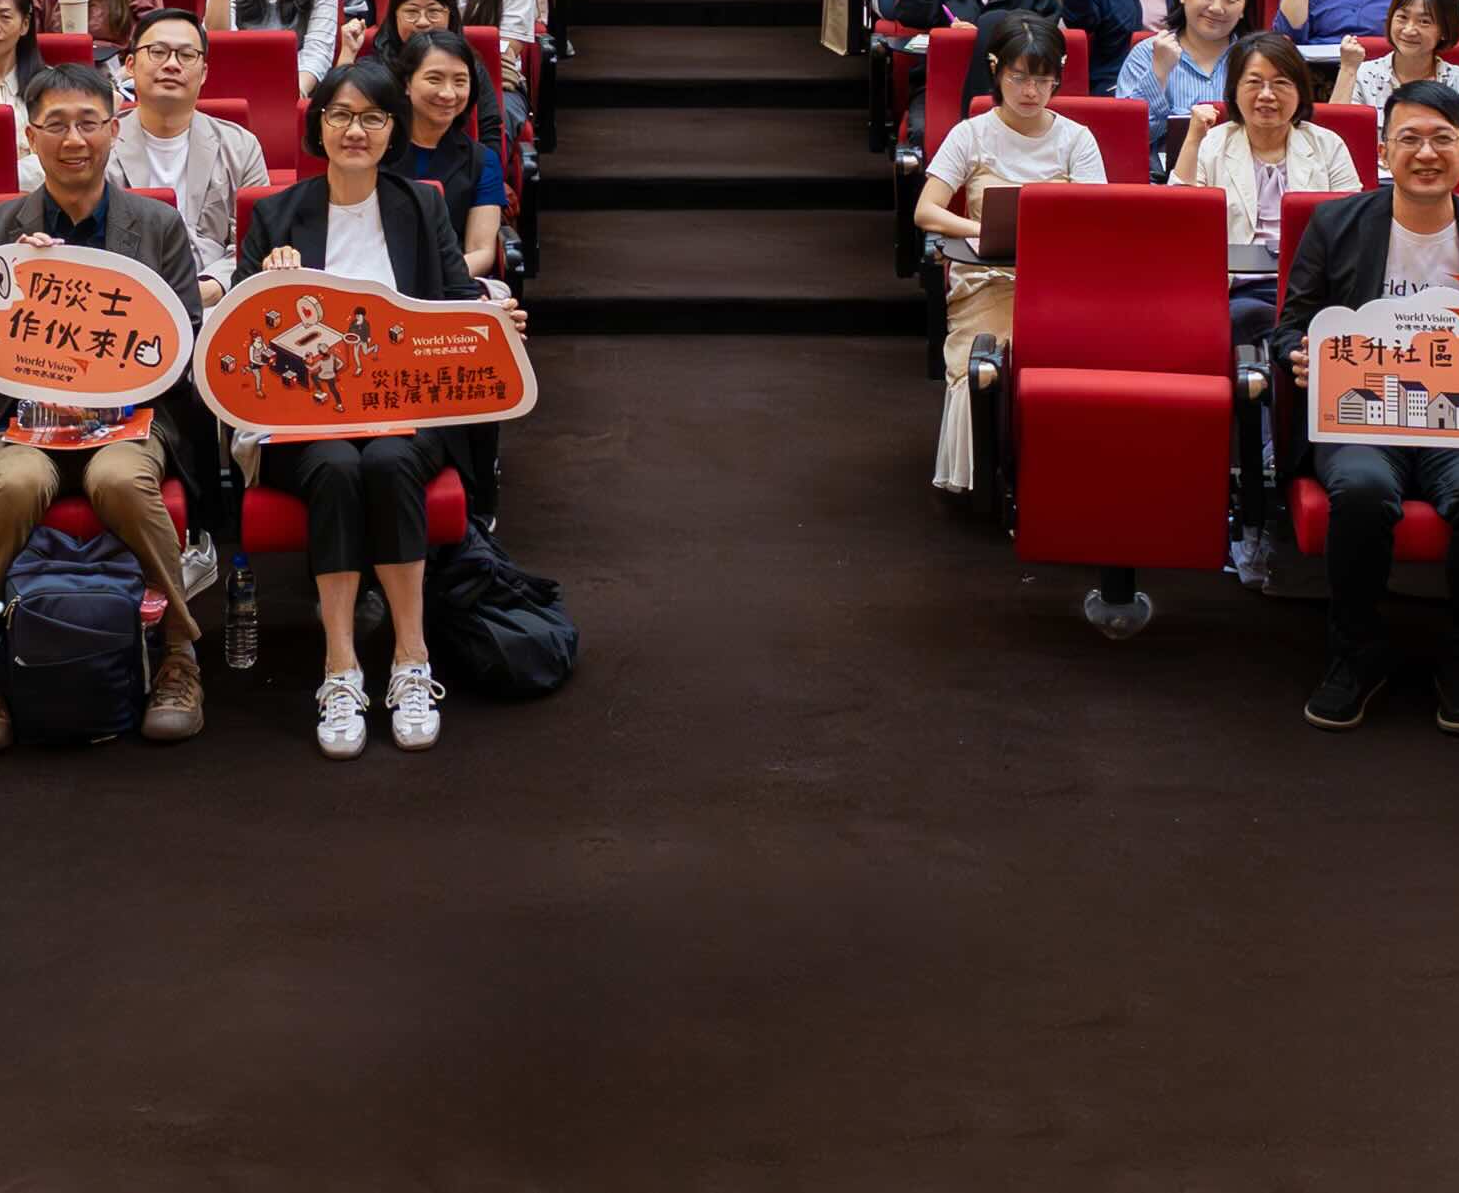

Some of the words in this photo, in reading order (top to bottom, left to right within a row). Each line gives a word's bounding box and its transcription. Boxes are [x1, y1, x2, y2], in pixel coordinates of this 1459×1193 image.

[29, 272, 132, 317] 防災士
[1394, 312, 1424, 322] World
[1426, 313, 1456, 323] Vision
[412, 335, 444, 347] World
[446, 334, 478, 344] Vision
[16, 354, 46, 368] World
[48, 360, 77, 374] Vision
[371, 366, 499, 389] 災後社區韌性
